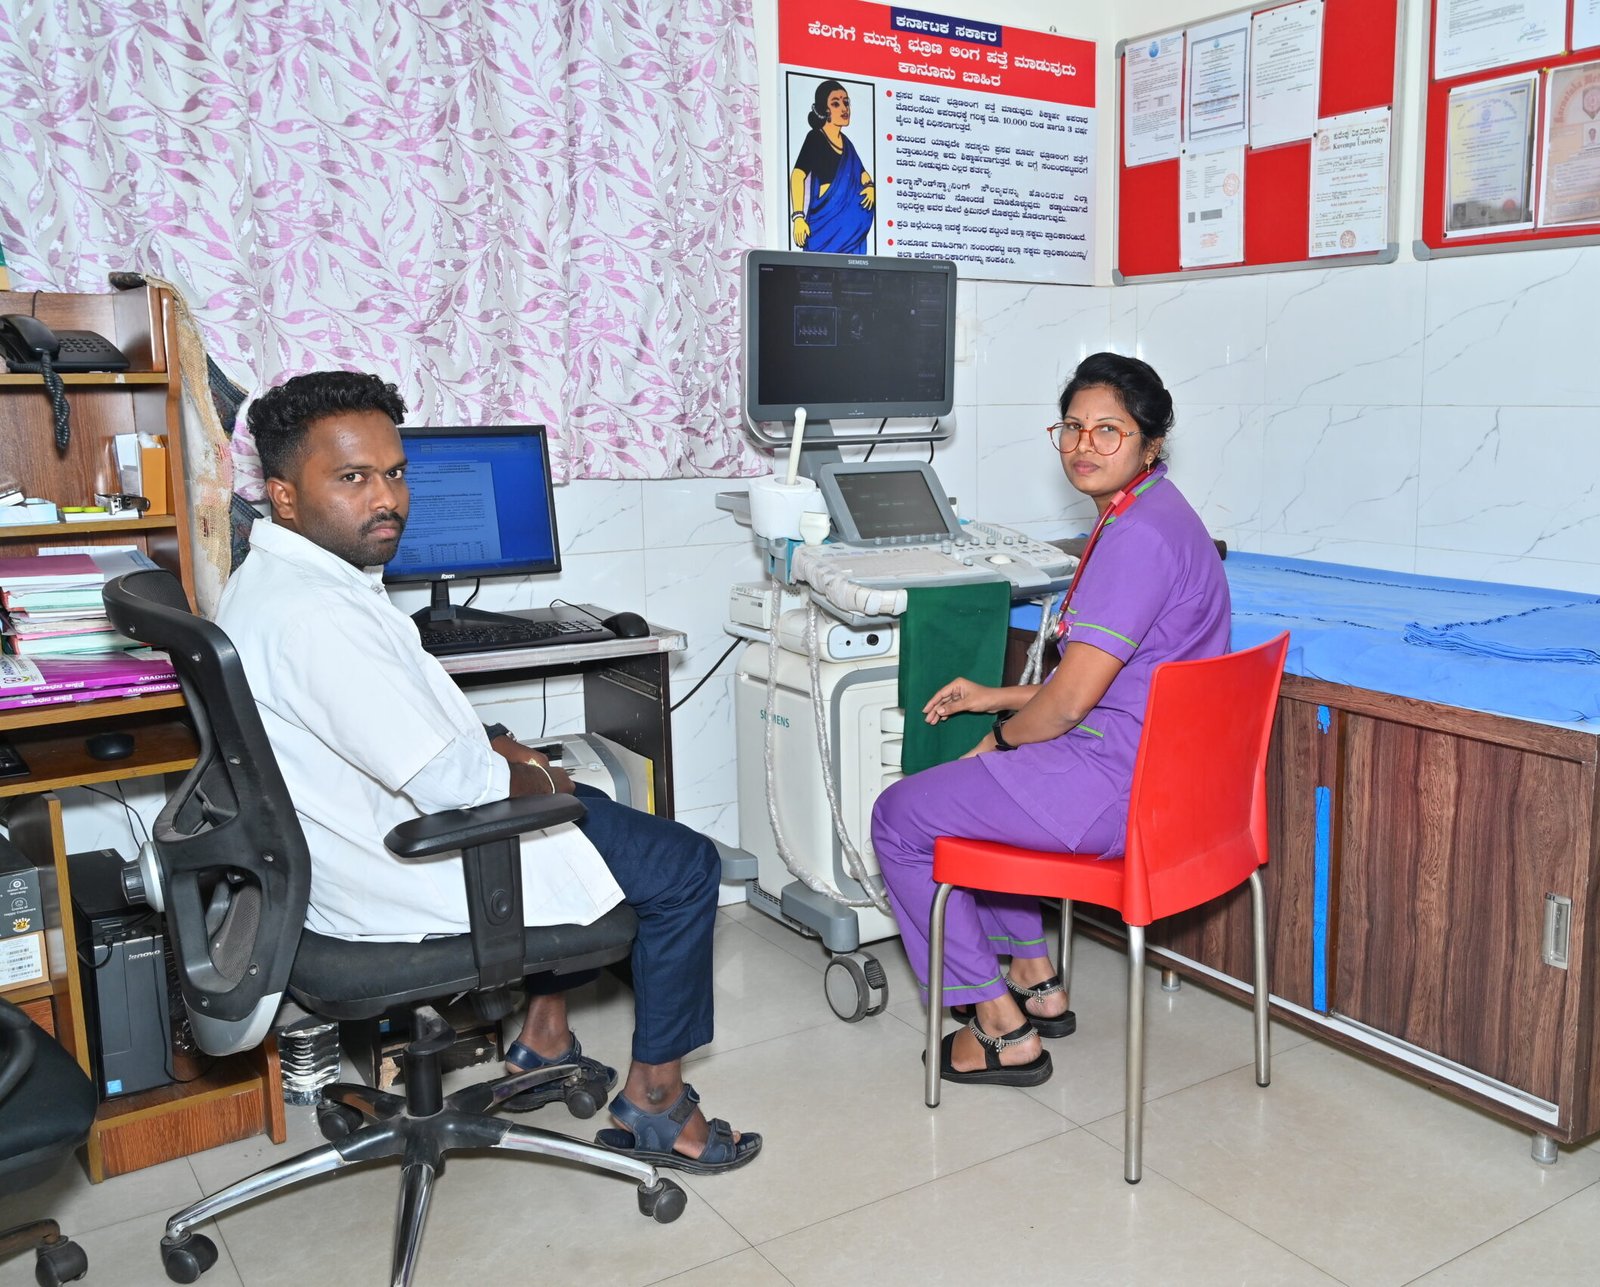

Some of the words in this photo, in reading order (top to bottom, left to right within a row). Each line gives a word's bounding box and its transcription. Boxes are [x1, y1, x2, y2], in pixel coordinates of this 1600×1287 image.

[896, 16, 949, 34] ಕರ್ನಾಟಕ
[956, 25, 997, 42] ಸರ್ಕಾರ
[808, 20, 856, 41] ಹೆರಿಗೆಗೆ
[863, 32, 901, 54] ಮುನ್ನ
[908, 39, 942, 56] ಭ್ರೂಣ
[950, 46, 980, 60] ಲಿಂಗ
[987, 51, 1008, 69] ಪತ್ತೆ
[1014, 56, 1076, 76] ಮಾಡುವುದು
[898, 61, 956, 80] ಕಾನೂನು
[963, 71, 1001, 86] ಬಾಹಿರ
[128, 684, 171, 693] ARADHANA
[128, 949, 160, 960] lenovo
